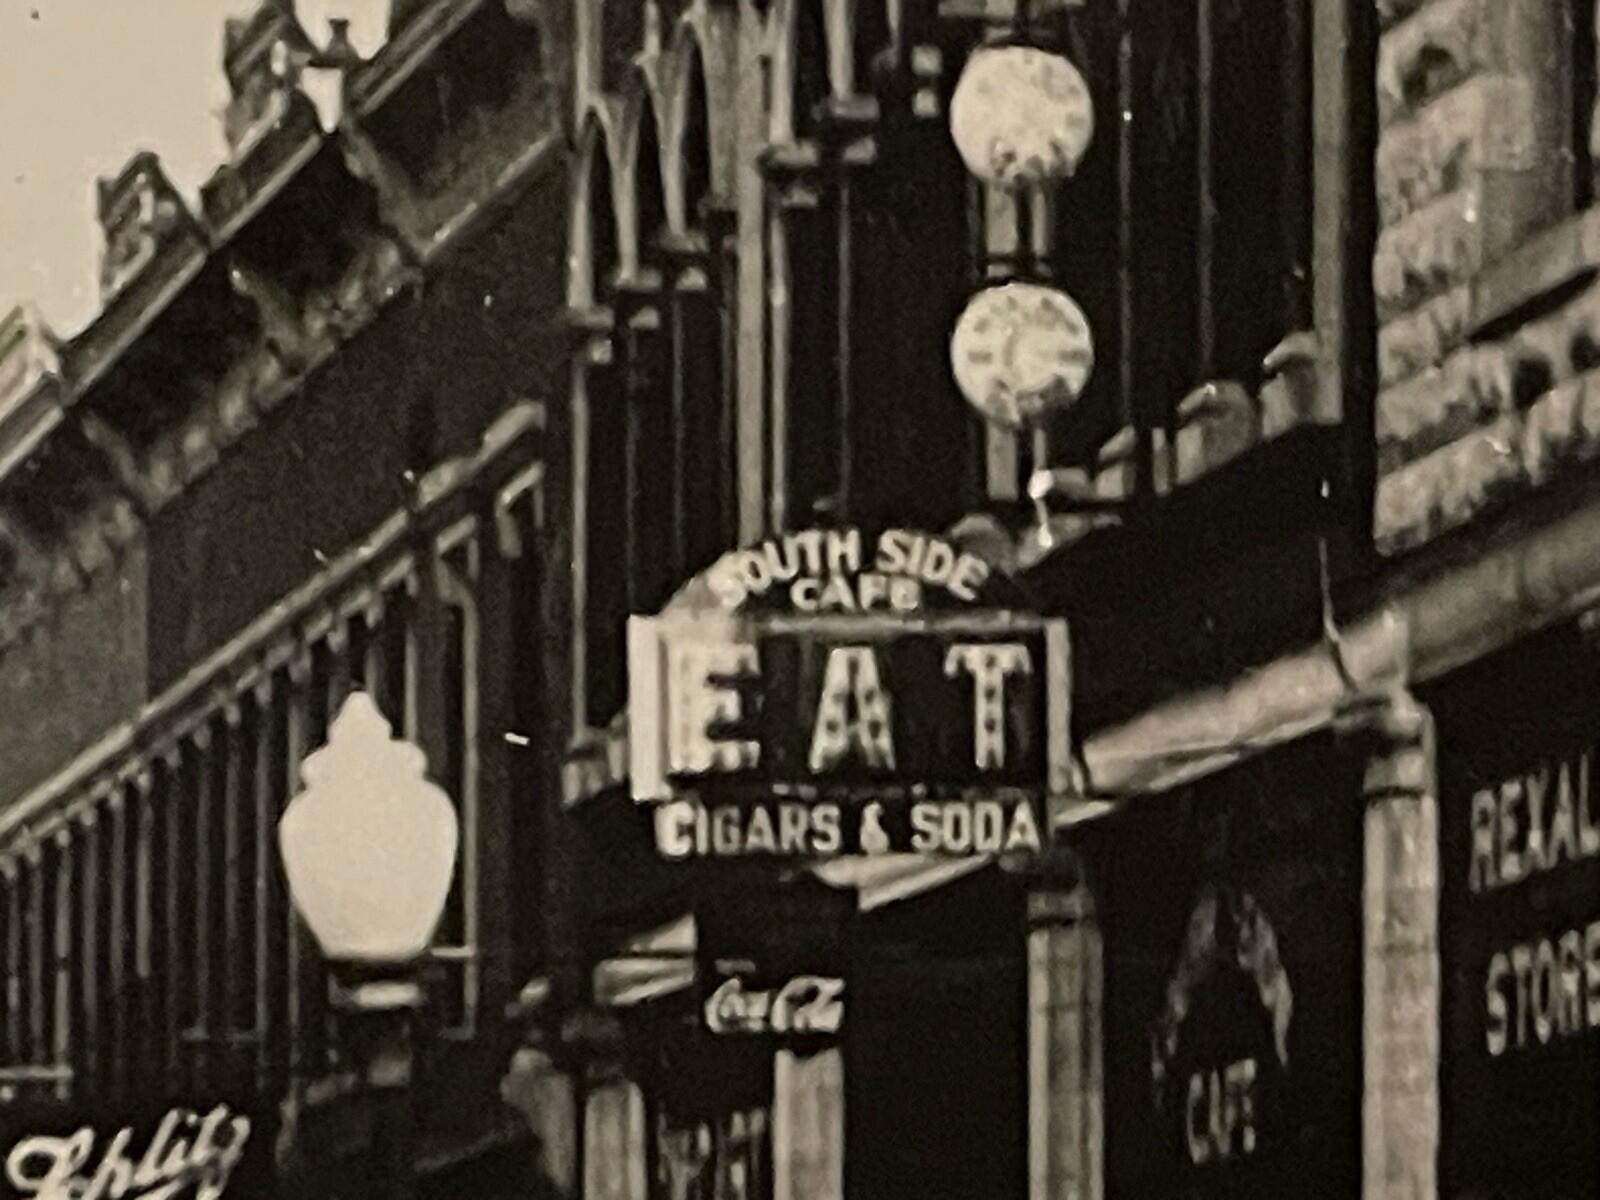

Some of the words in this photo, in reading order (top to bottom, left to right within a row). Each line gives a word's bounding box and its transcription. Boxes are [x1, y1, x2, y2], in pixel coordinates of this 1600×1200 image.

[704, 529, 861, 610] SOUTH
[875, 529, 990, 600] SIDE
[667, 643, 1033, 772] EAT
[654, 801, 842, 857] CIGARS
[910, 800, 1042, 854] SODA
